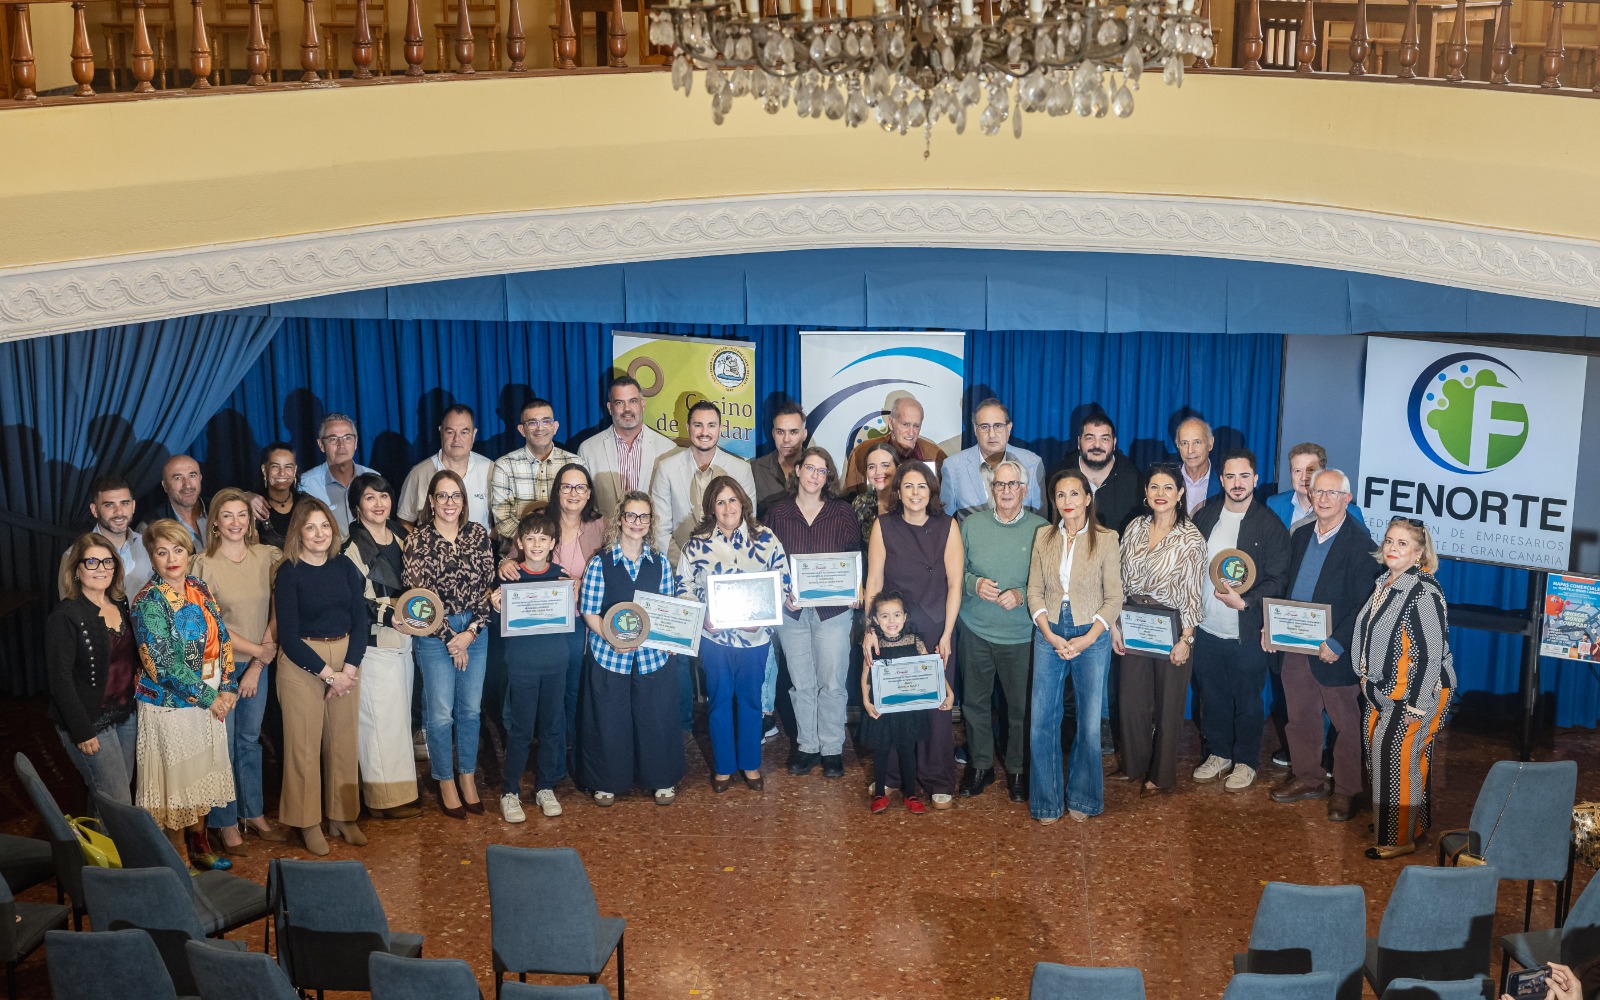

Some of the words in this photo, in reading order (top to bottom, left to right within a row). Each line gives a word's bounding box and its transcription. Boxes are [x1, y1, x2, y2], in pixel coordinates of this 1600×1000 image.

[685, 393, 752, 418] Cino
[656, 413, 679, 433] de
[1364, 476, 1567, 533] FENORTE
[1451, 528, 1466, 538] DE
[1476, 531, 1564, 551] EMPRESARIOS
[1452, 543, 1466, 553] DE
[1470, 545, 1504, 558] GRAN
[1508, 550, 1563, 566] CANARIA
